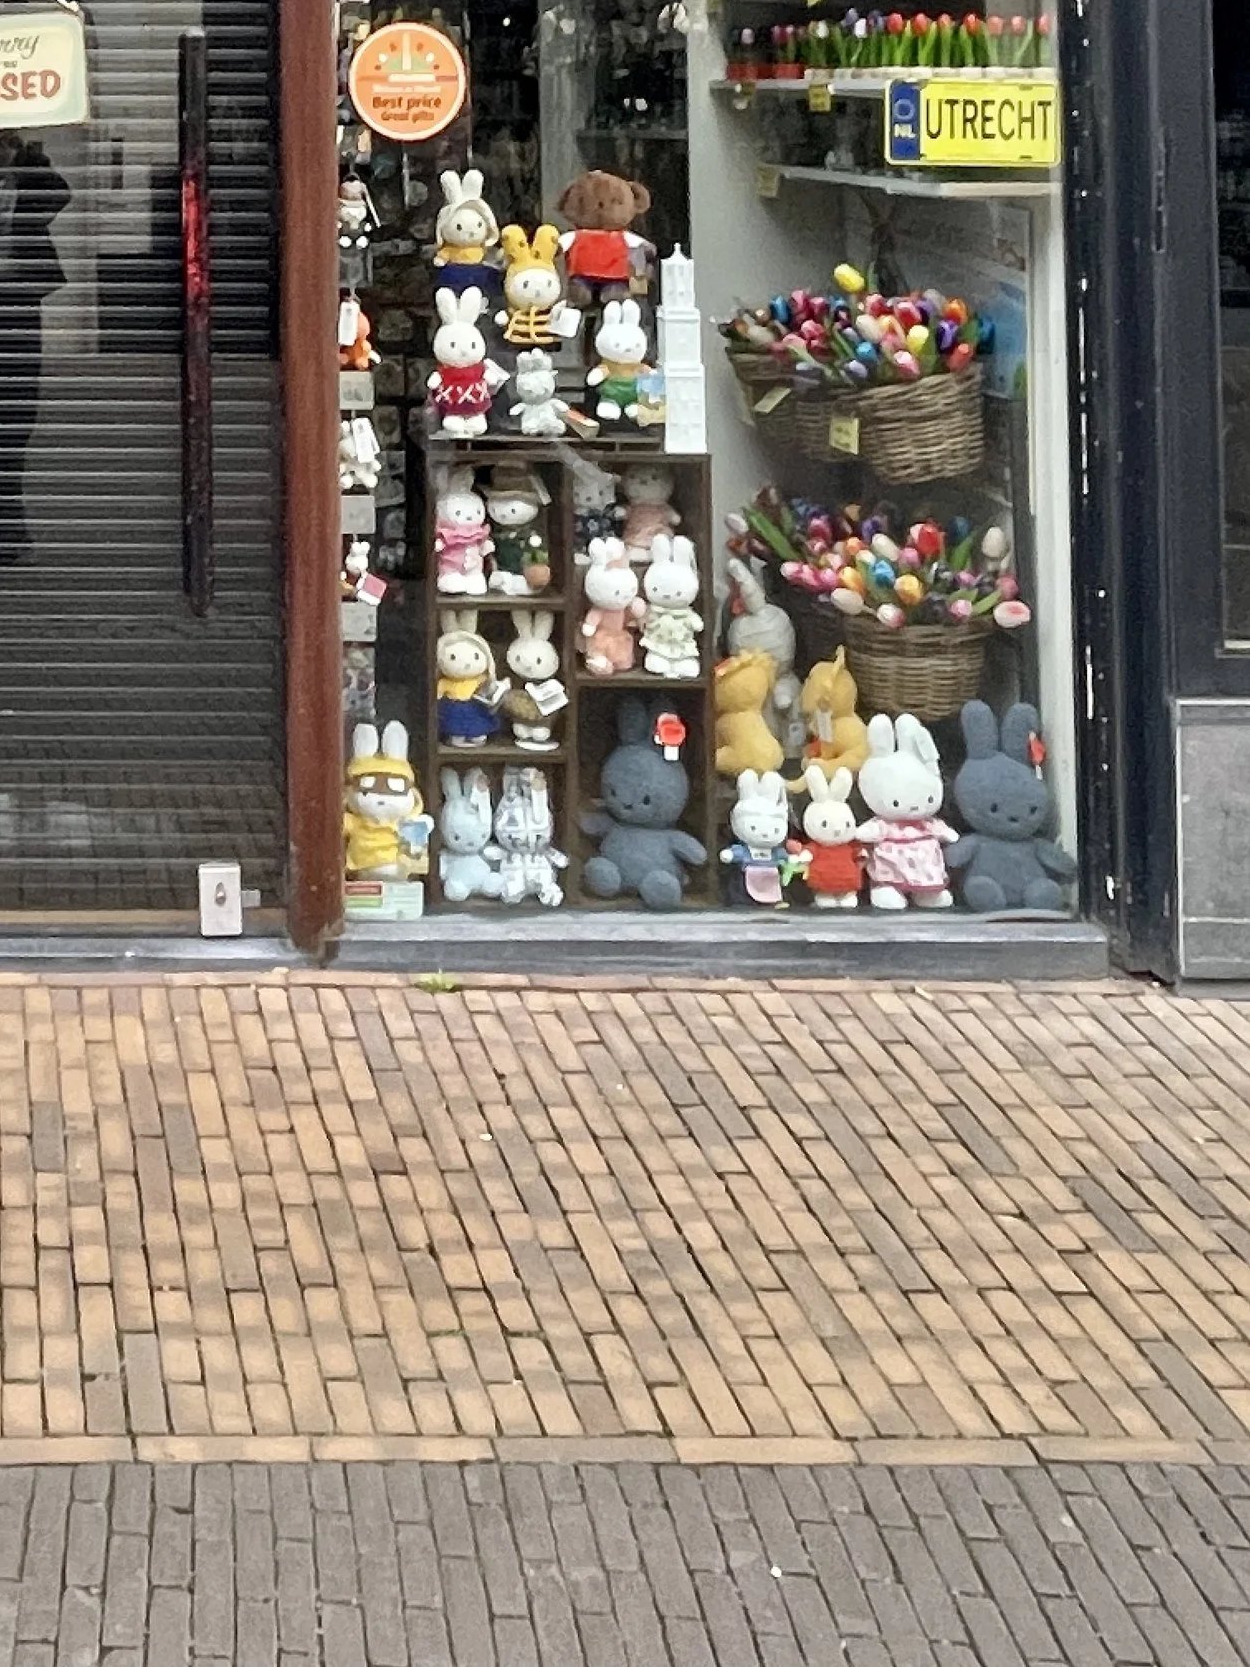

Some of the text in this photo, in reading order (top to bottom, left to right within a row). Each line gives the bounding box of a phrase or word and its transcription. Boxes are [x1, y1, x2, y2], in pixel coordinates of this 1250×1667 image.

[372, 95, 442, 111] Best price
[925, 98, 1052, 142] UTRECHT
